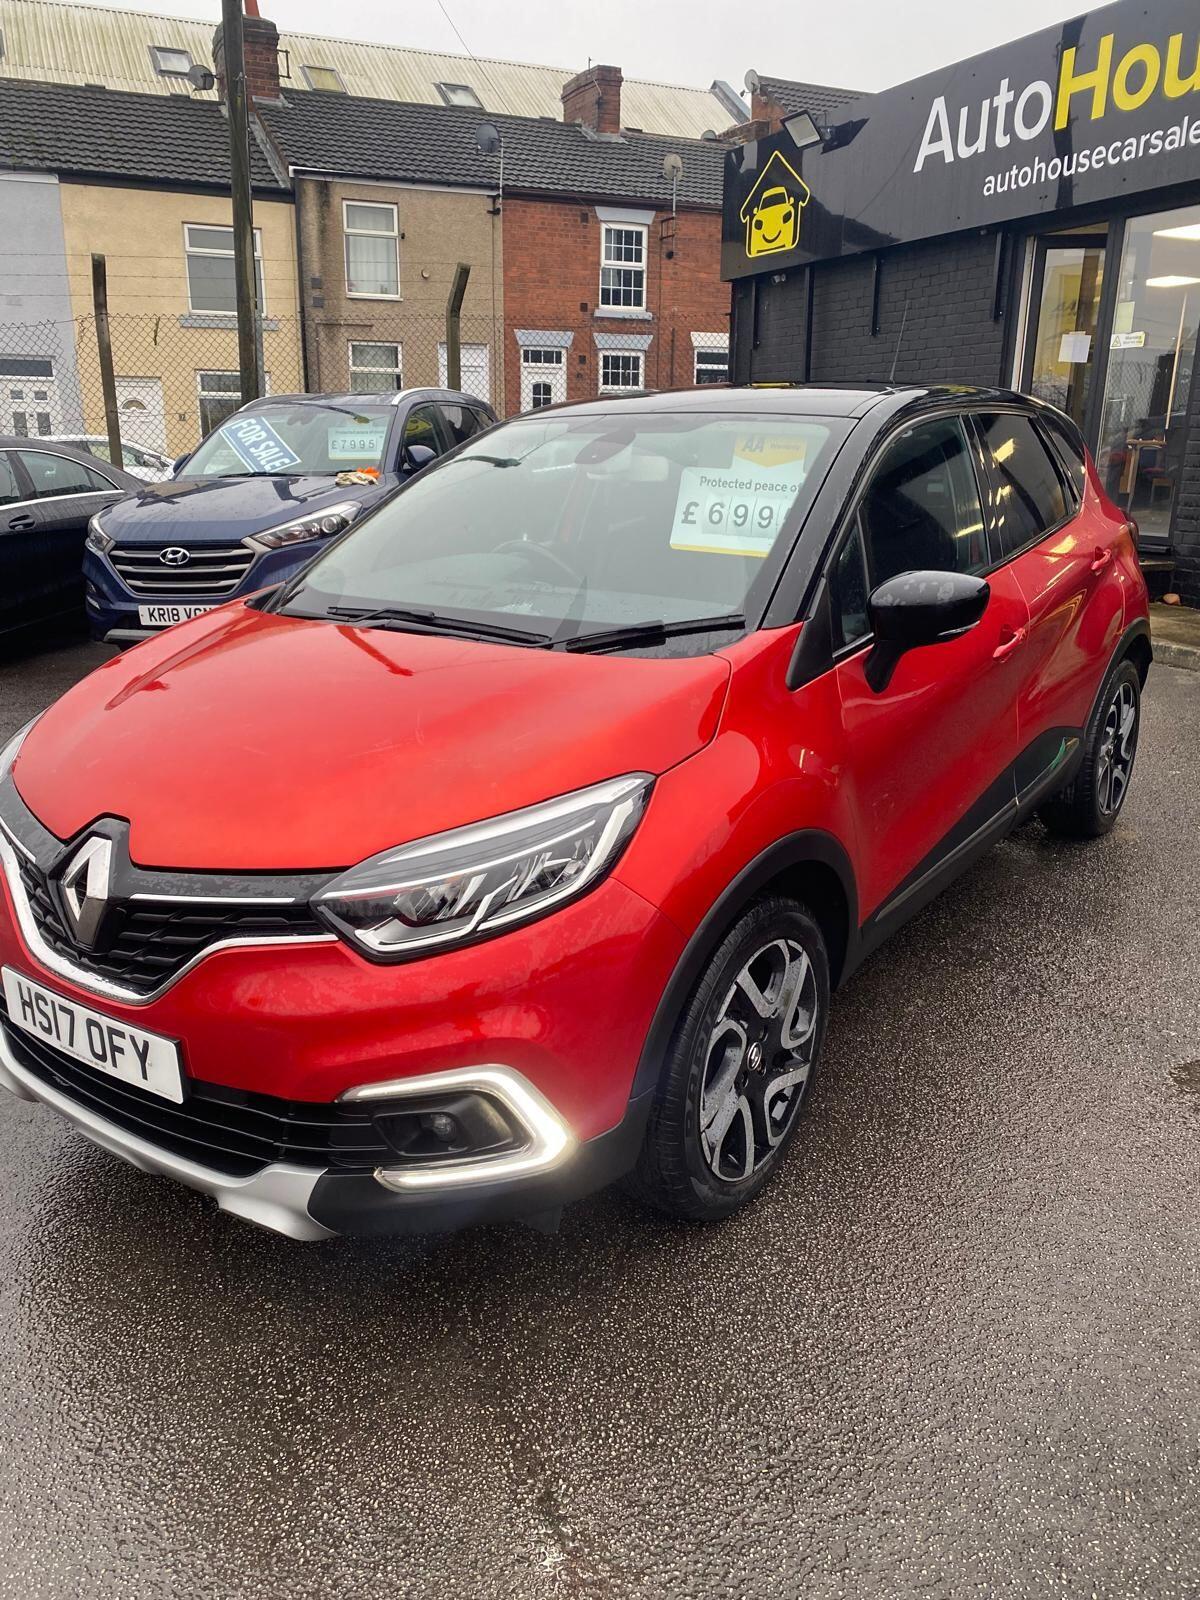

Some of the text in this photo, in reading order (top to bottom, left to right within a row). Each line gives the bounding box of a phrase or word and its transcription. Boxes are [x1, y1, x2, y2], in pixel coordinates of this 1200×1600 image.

[913, 33, 1200, 173] AutoHou
[231, 418, 267, 446] FOR
[331, 439, 375, 450] £7995
[249, 440, 290, 471] SALE
[699, 476, 752, 490] Protected
[754, 482, 788, 492] peace
[681, 501, 791, 529] £699
[147, 607, 180, 622] KR18
[17, 981, 150, 1081] HS17 OFY
